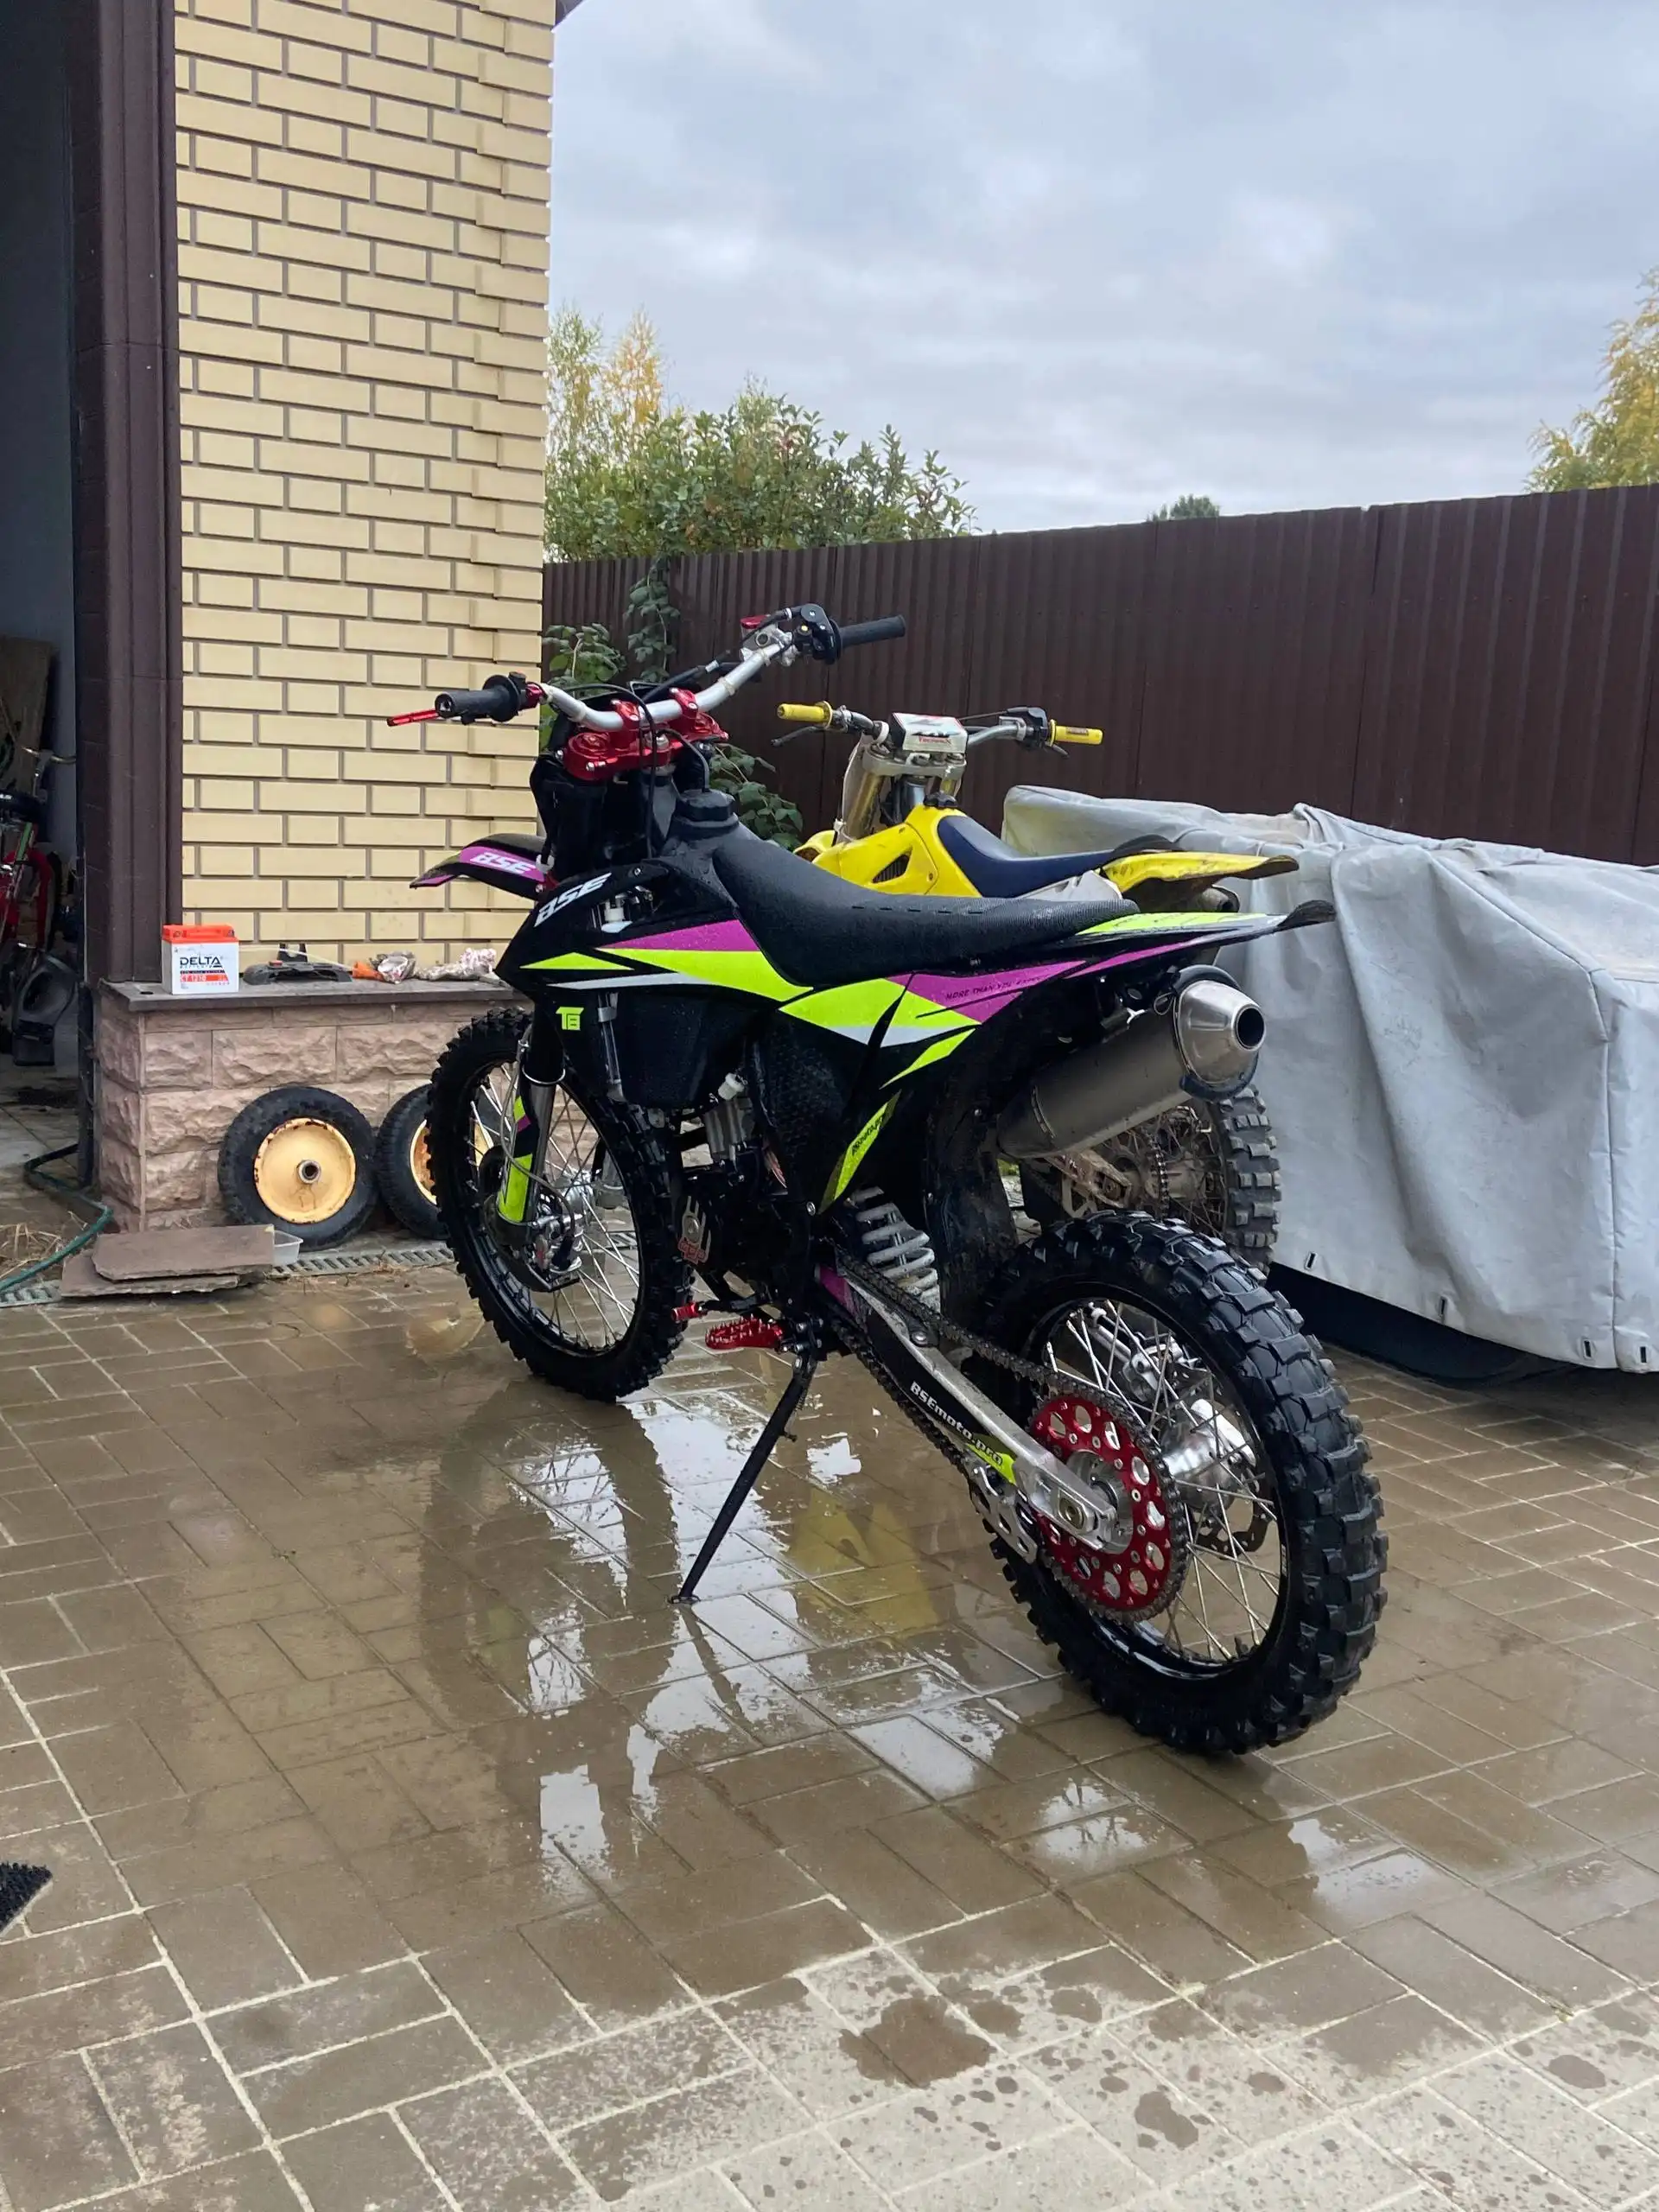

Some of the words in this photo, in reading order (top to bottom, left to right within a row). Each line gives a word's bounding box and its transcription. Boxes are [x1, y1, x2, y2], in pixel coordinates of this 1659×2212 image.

[470, 852, 535, 874] BSE
[534, 872, 612, 928] BSE
[180, 957, 220, 965] DELTA
[945, 989, 969, 1000] MORE
[973, 984, 994, 995] THAN
[910, 1381, 1003, 1465] BSEmoto.pro
